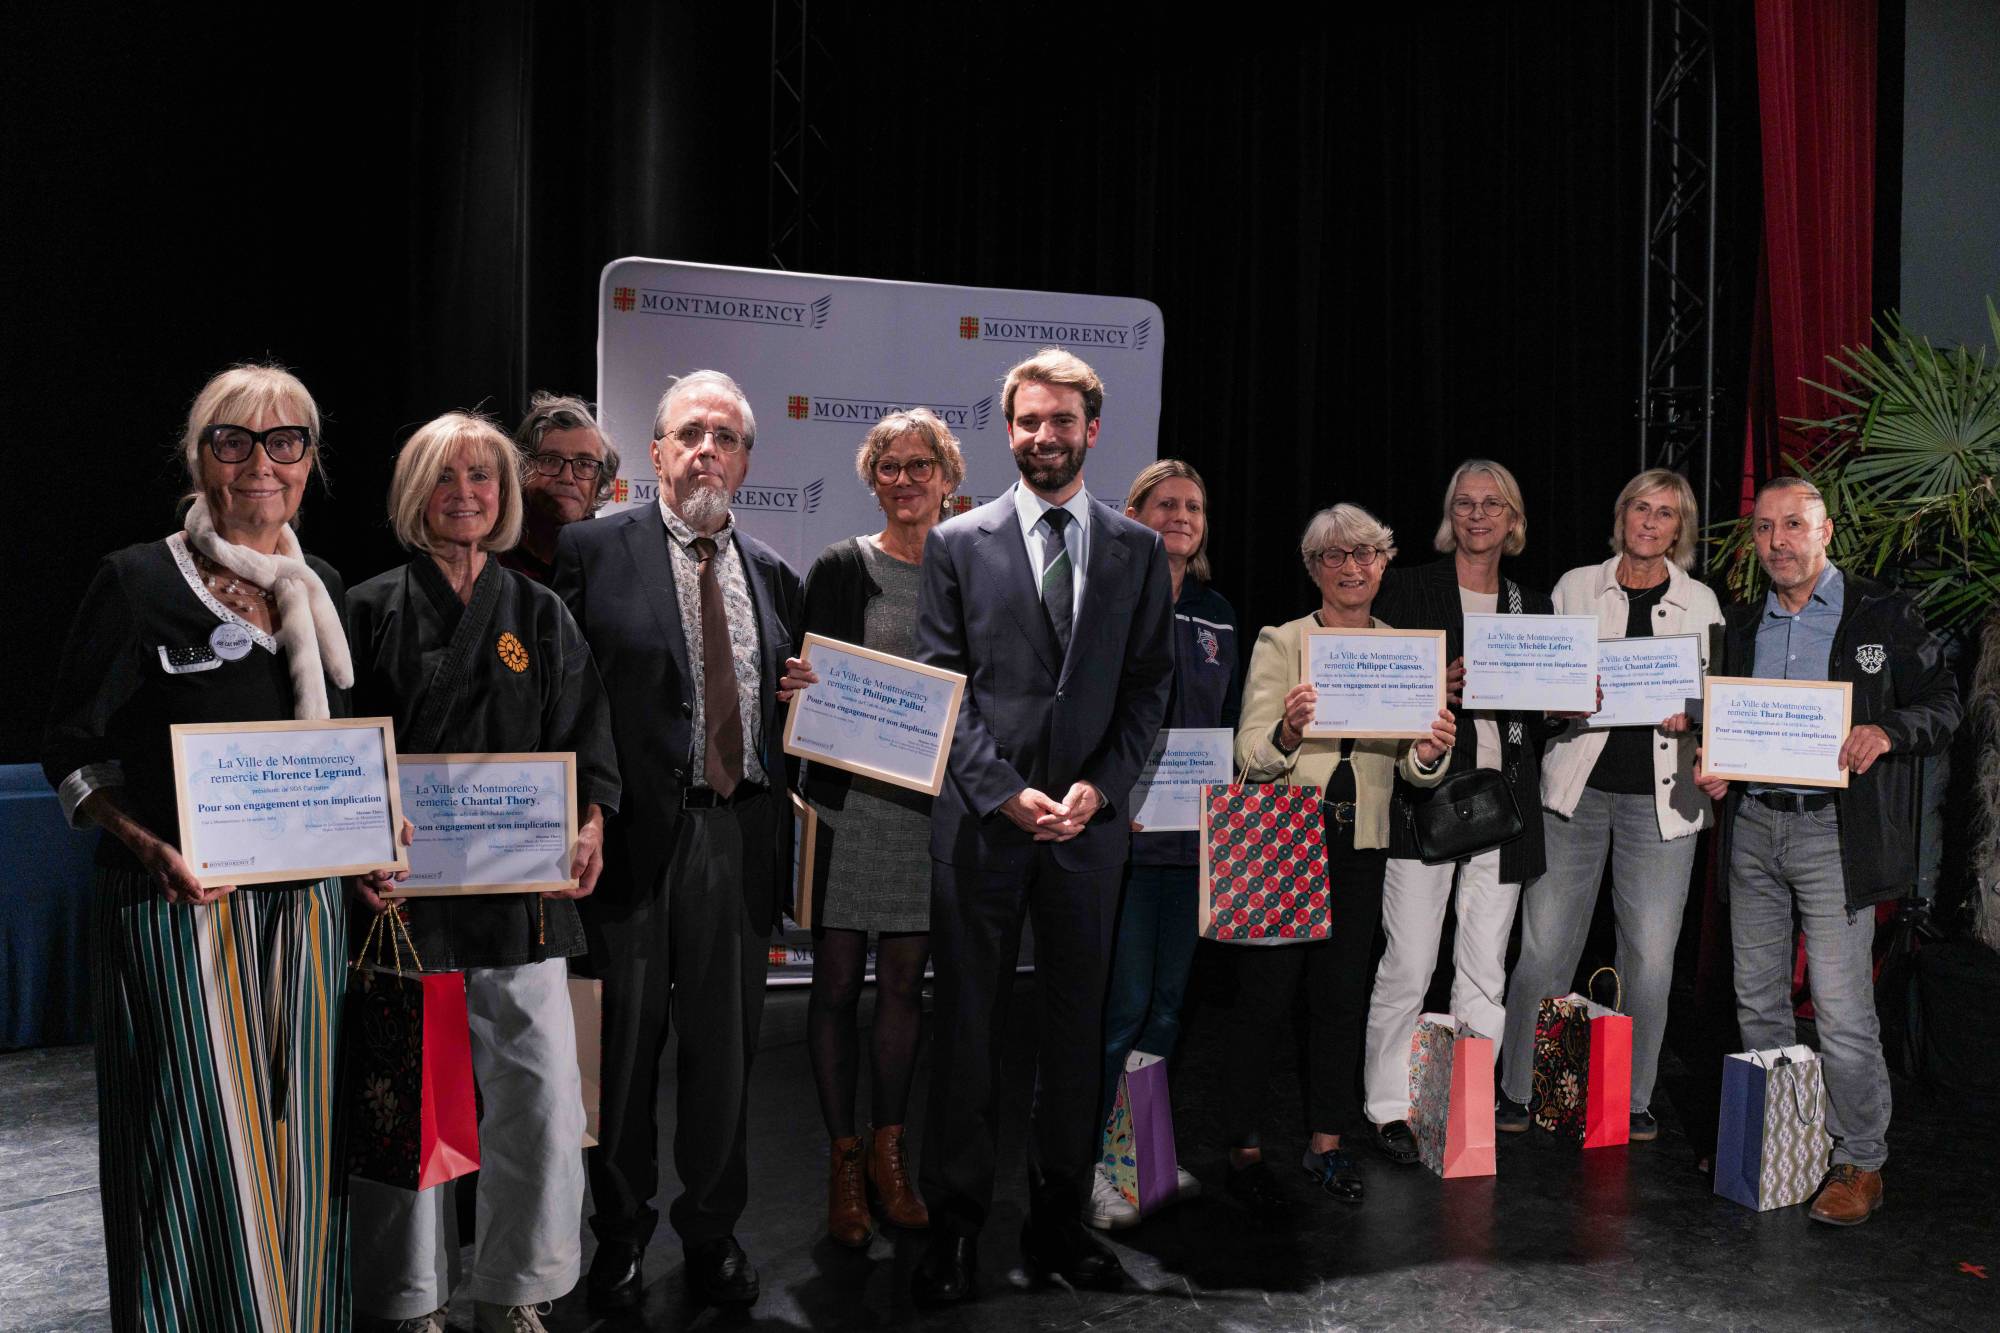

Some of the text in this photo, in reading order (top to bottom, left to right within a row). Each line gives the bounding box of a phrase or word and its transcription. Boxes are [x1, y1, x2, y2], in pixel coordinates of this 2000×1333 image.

[641, 294, 806, 322] MONTMORENCY
[984, 322, 1129, 344] MONTMORENCY
[815, 402, 968, 424] MONTMNCY
[634, 484, 798, 507] MRENCY
[1488, 632, 1497, 640] La
[1499, 632, 1515, 640] Ville
[1526, 633, 1574, 642] Montmorency
[1341, 651, 1358, 660] Ville
[1360, 652, 1368, 660] de
[1370, 652, 1419, 661] Montmorency
[1324, 662, 1355, 670] remercie
[1356, 662, 1388, 671] Philippe
[1554, 660, 1588, 668] implication
[1624, 662, 1653, 670] Chantal
[830, 667, 928, 703] La Ville de Montmorency
[1400, 682, 1434, 690] implication
[827, 680, 861, 693] remercie
[862, 688, 897, 704] Philippe
[1731, 699, 1822, 712] La Ville de Montmorency
[806, 694, 823, 705] Pour
[824, 700, 836, 709] son
[837, 705, 877, 720] engagement
[899, 721, 938, 738] implication
[1727, 708, 1759, 717] remercie
[1760, 709, 1784, 718] Thara
[1743, 728, 1781, 736] engagement
[1801, 731, 1837, 740] implication
[218, 754, 356, 769] La Ville de Montmorency
[210, 771, 259, 784] remercie
[262, 769, 312, 781] Florence
[416, 784, 538, 795] La Ville de Montmorency
[198, 794, 382, 813] Pour son engagement et son implication
[416, 798, 458, 807] remercie
[461, 796, 502, 806] Chantal
[435, 823, 485, 832] engagement
[514, 820, 560, 831] implication
